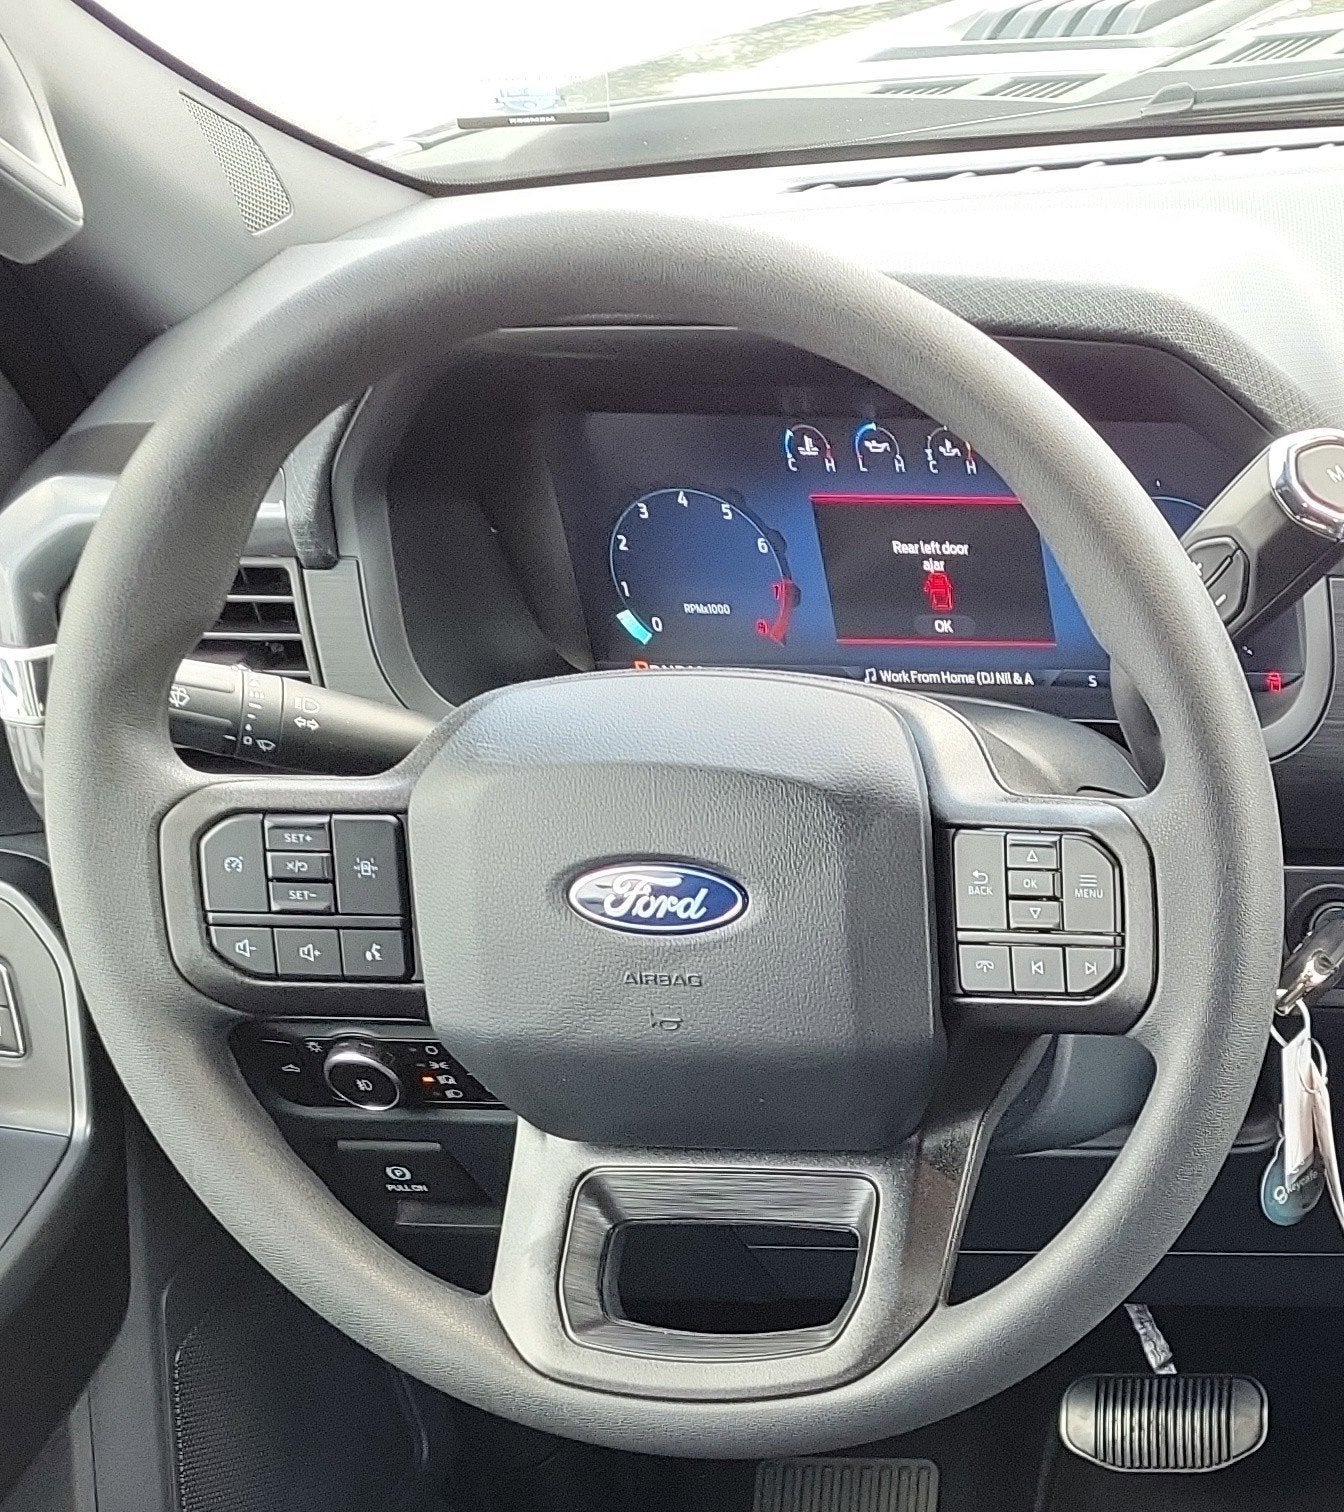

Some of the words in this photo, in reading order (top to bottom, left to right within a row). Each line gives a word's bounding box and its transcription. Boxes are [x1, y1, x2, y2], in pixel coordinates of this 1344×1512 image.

[788, 458, 798, 471] C
[825, 458, 836, 473] H
[894, 456, 906, 473] H
[929, 461, 939, 474] C
[966, 460, 977, 475] H
[677, 491, 688, 507] 4
[637, 503, 648, 518] 3
[721, 504, 732, 520] 5
[617, 535, 628, 551] 2
[757, 538, 769, 553] 6
[892, 540, 919, 555] Rear
[920, 541, 941, 555] left
[942, 542, 969, 556] door
[923, 559, 945, 573] ajar
[621, 581, 630, 597] 1
[651, 617, 663, 632] 0
[934, 620, 953, 633] OK
[880, 670, 909, 683] Work
[911, 670, 941, 684] From
[941, 671, 975, 684] Home
[977, 671, 997, 686] (DJ
[998, 672, 1013, 685] Nil
[1013, 673, 1023, 685] &
[1024, 673, 1034, 685] A
[1089, 675, 1097, 687] S
[968, 884, 993, 896] BACK
[1023, 879, 1037, 888] OK
[604, 873, 708, 920] Ford
[1074, 887, 1103, 899] MENU
[624, 971, 702, 987] AIRBAG
[387, 1184, 409, 1192] PULL
